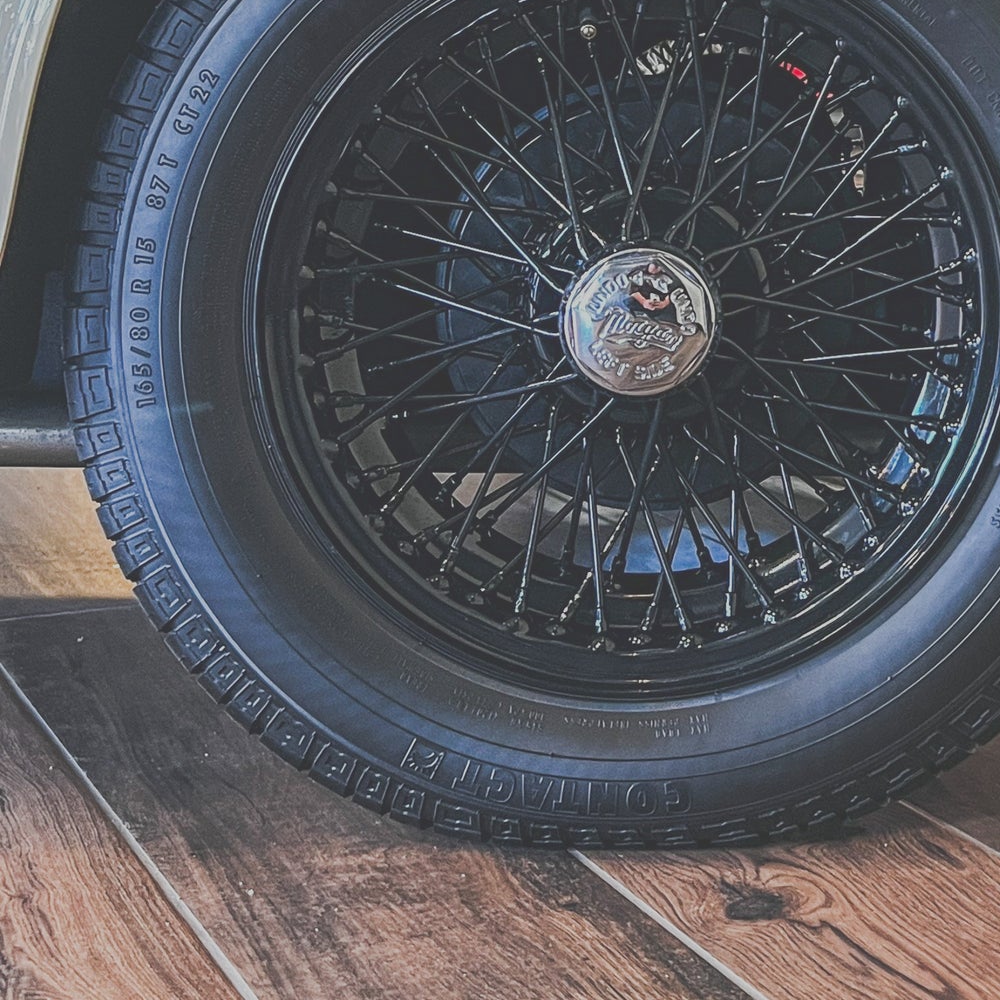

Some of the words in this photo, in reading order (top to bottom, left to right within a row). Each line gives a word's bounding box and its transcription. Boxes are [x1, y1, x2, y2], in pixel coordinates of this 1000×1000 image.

[173, 68, 221, 136] CT22
[133, 236, 157, 265] 15
[130, 278, 152, 295] R
[129, 306, 157, 409] 165/80
[451, 758, 692, 816] CONTACT
